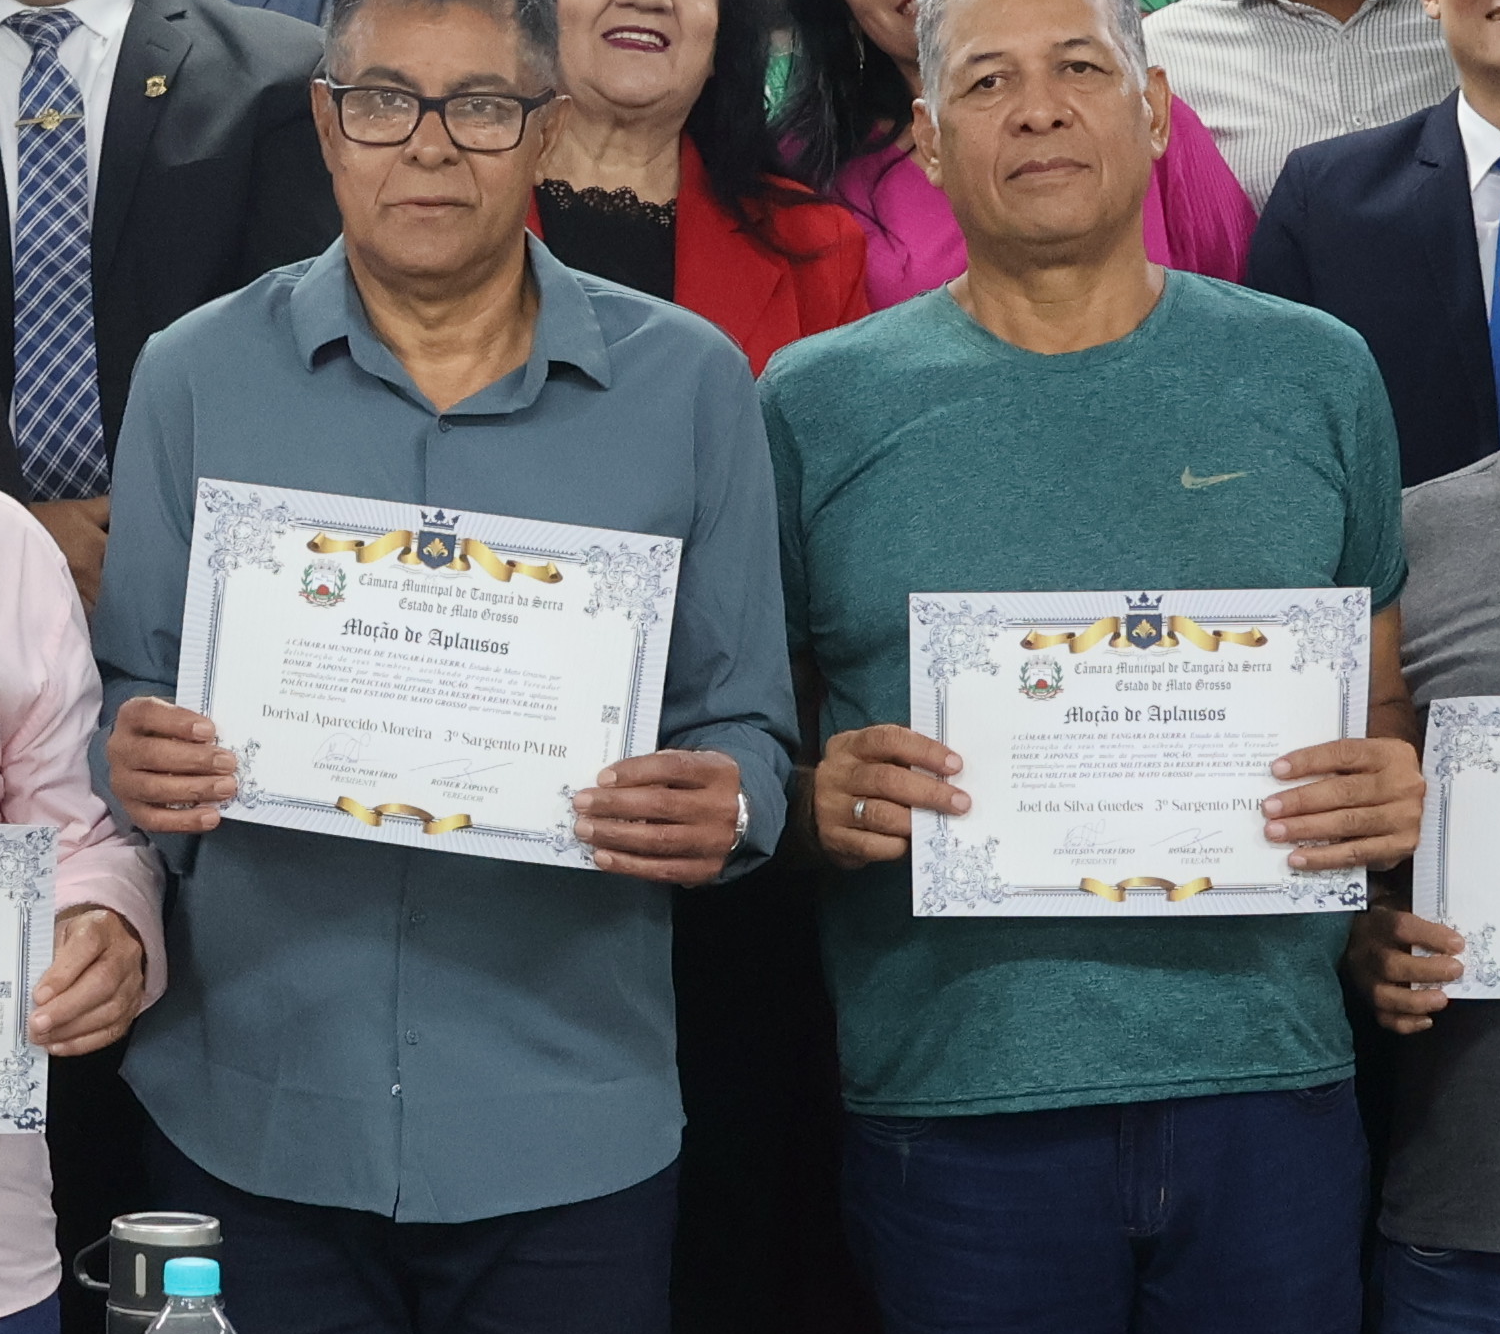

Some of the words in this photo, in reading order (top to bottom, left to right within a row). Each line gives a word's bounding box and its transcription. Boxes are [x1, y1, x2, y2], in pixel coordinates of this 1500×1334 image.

[340, 617, 399, 643] Moção
[404, 625, 423, 644] de
[427, 628, 510, 656] Aplausos
[262, 703, 309, 723] Dorival
[315, 711, 378, 732] Aparecido
[382, 720, 432, 740] Moreira
[461, 732, 521, 752] Sargento
[523, 740, 545, 756] PM
[548, 743, 568, 759] RR
[1063, 705, 1119, 727] Moção
[1124, 706, 1142, 722] de
[1147, 704, 1226, 725] Aplausos
[1016, 799, 1042, 813] Joel
[1044, 800, 1061, 813] da
[1063, 800, 1094, 812] Silva
[1097, 799, 1144, 812] Guedes
[1171, 799, 1230, 814] Sargento
[1232, 798, 1253, 811] PM
[1252, 799, 1265, 812] R
